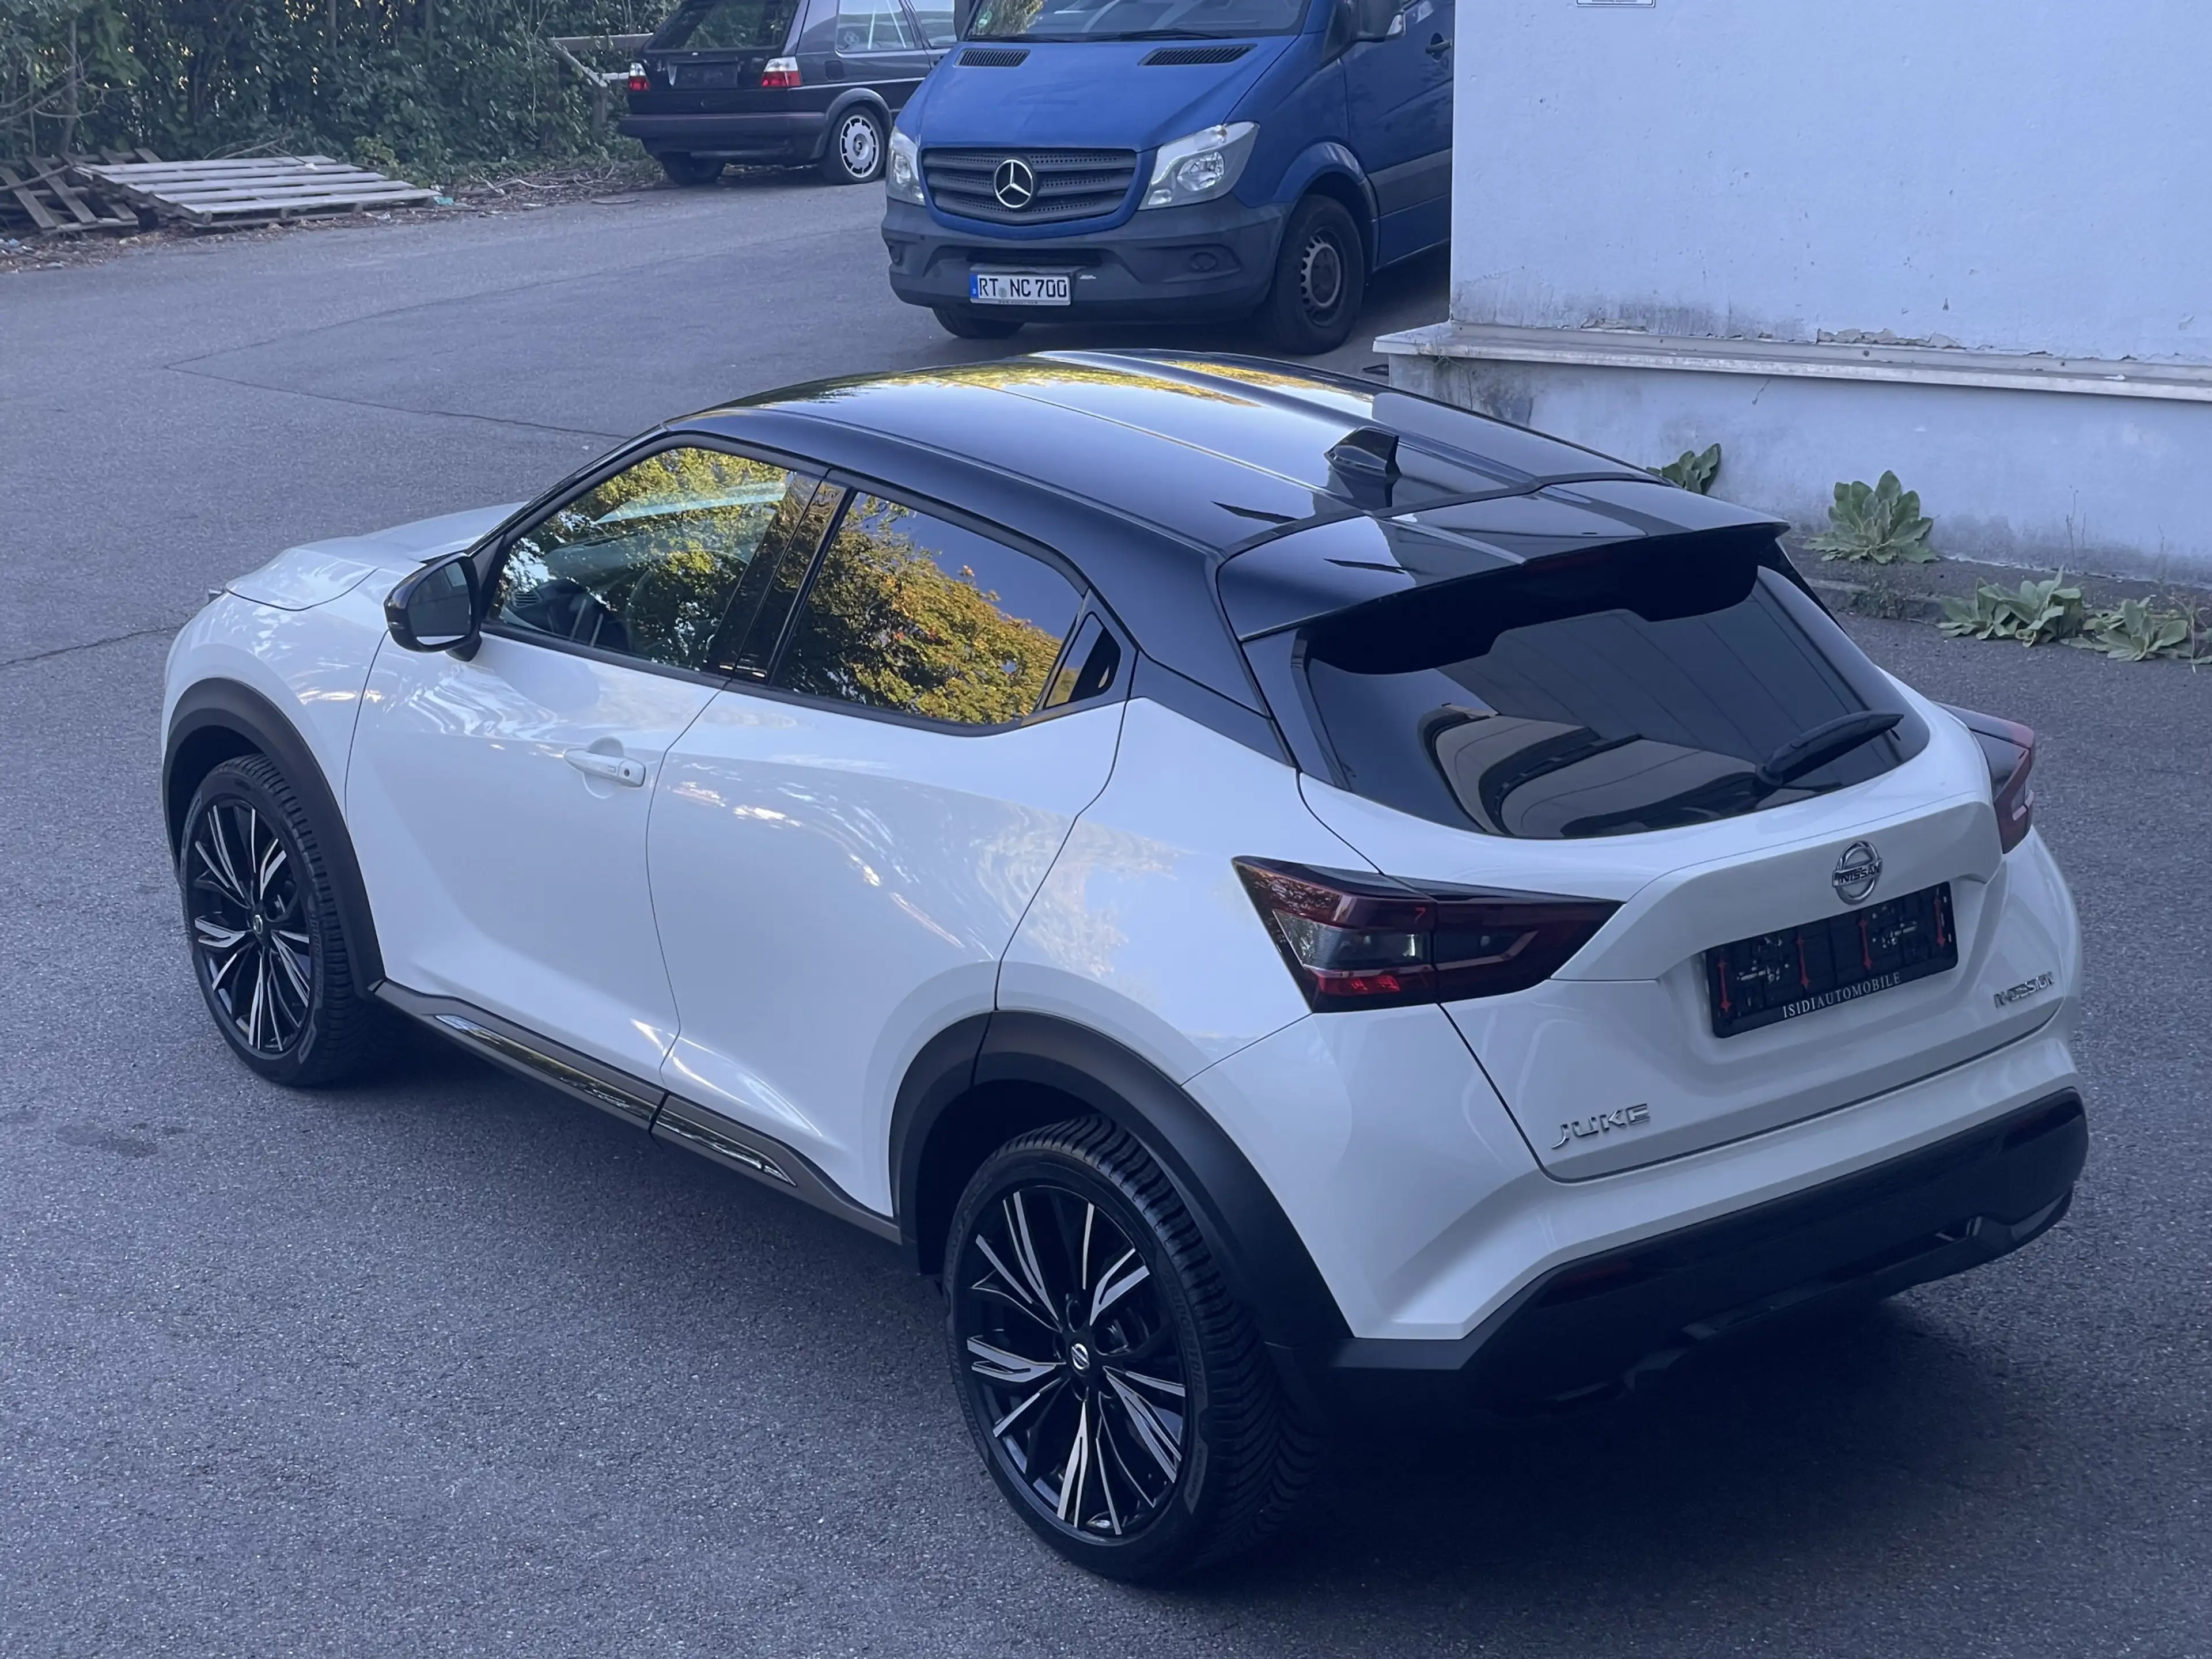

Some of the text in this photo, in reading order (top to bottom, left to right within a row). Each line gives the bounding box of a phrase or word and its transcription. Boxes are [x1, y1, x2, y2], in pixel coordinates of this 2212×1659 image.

[979, 278, 1067, 298] RT NC 700
[1839, 864, 1879, 884] NISSAN
[1783, 972, 1902, 1018] ISIDIAUTOMOBILE
[1551, 1103, 1651, 1150] JUKE
